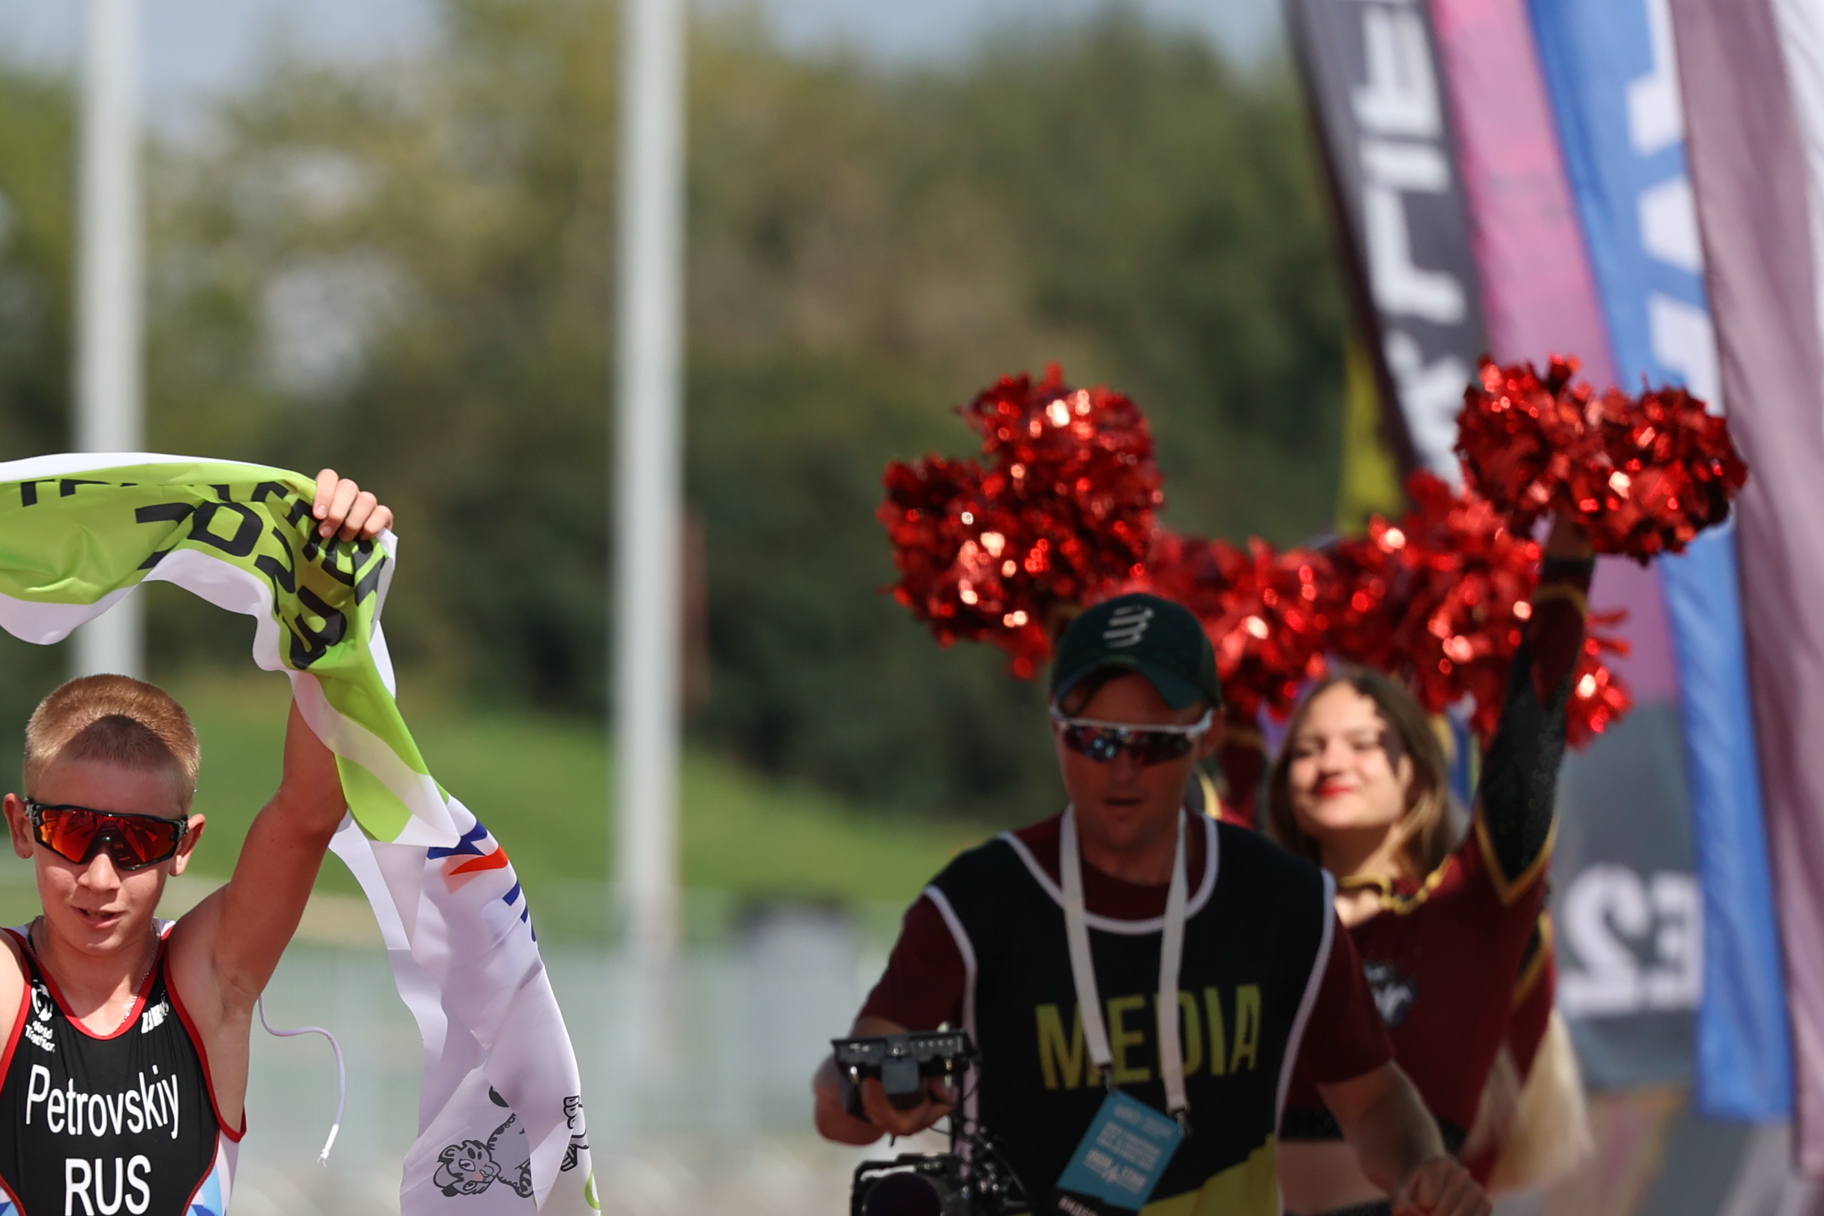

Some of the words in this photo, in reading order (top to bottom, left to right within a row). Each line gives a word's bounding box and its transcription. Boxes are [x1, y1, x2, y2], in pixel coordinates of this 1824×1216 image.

[1034, 984, 1262, 1090] MEDIA
[26, 1064, 180, 1139] Petrovskiy
[64, 1155, 152, 1216] RUS
